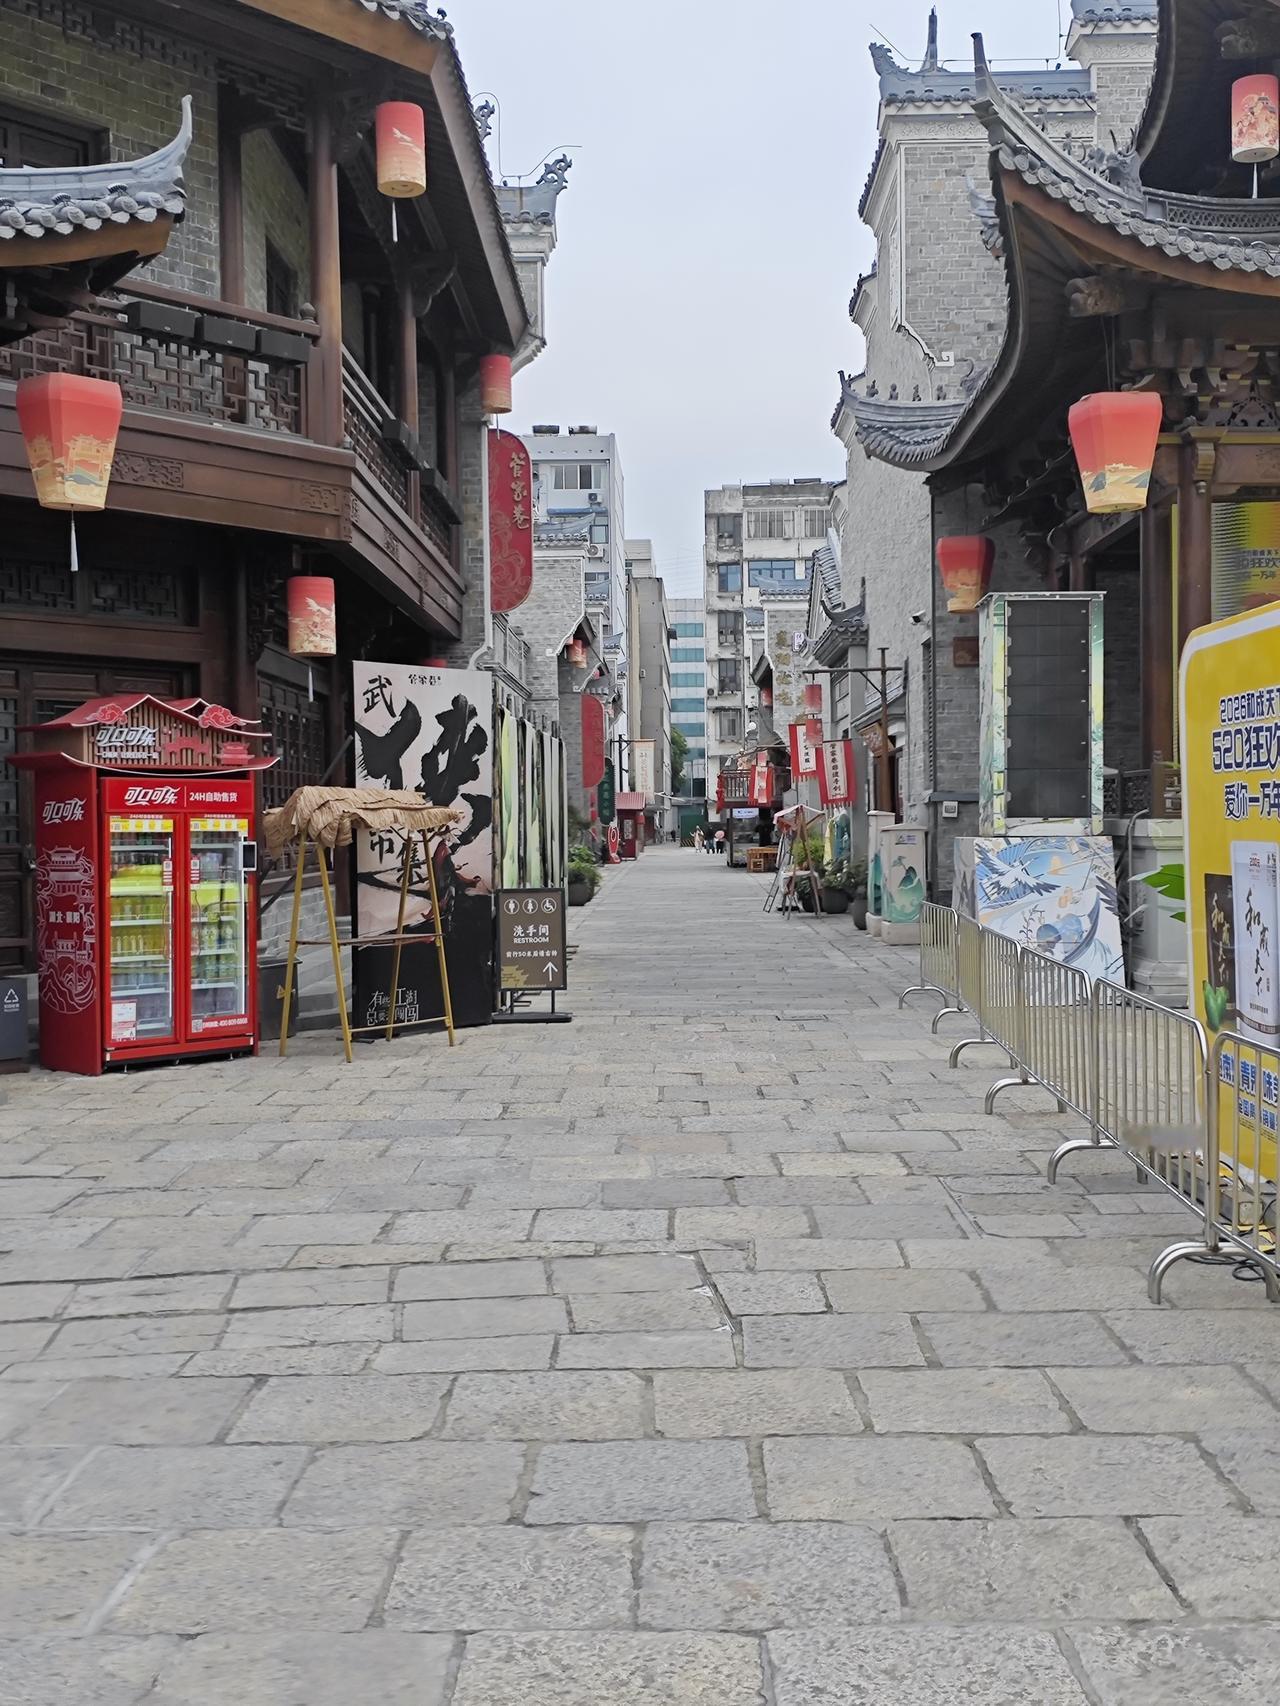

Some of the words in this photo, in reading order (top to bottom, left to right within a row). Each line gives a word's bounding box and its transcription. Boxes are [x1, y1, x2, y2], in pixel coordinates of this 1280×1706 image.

[509, 451, 530, 531] 管家巷
[362, 674, 397, 718] 武
[1220, 687, 1280, 723] 2026和成天
[96, 725, 159, 747] 可口可乐
[124, 785, 181, 806] 可口可乐
[189, 791, 238, 803] 24H自助售货
[42, 797, 87, 824] 可口可乐
[513, 924, 549, 937] 洗手间
